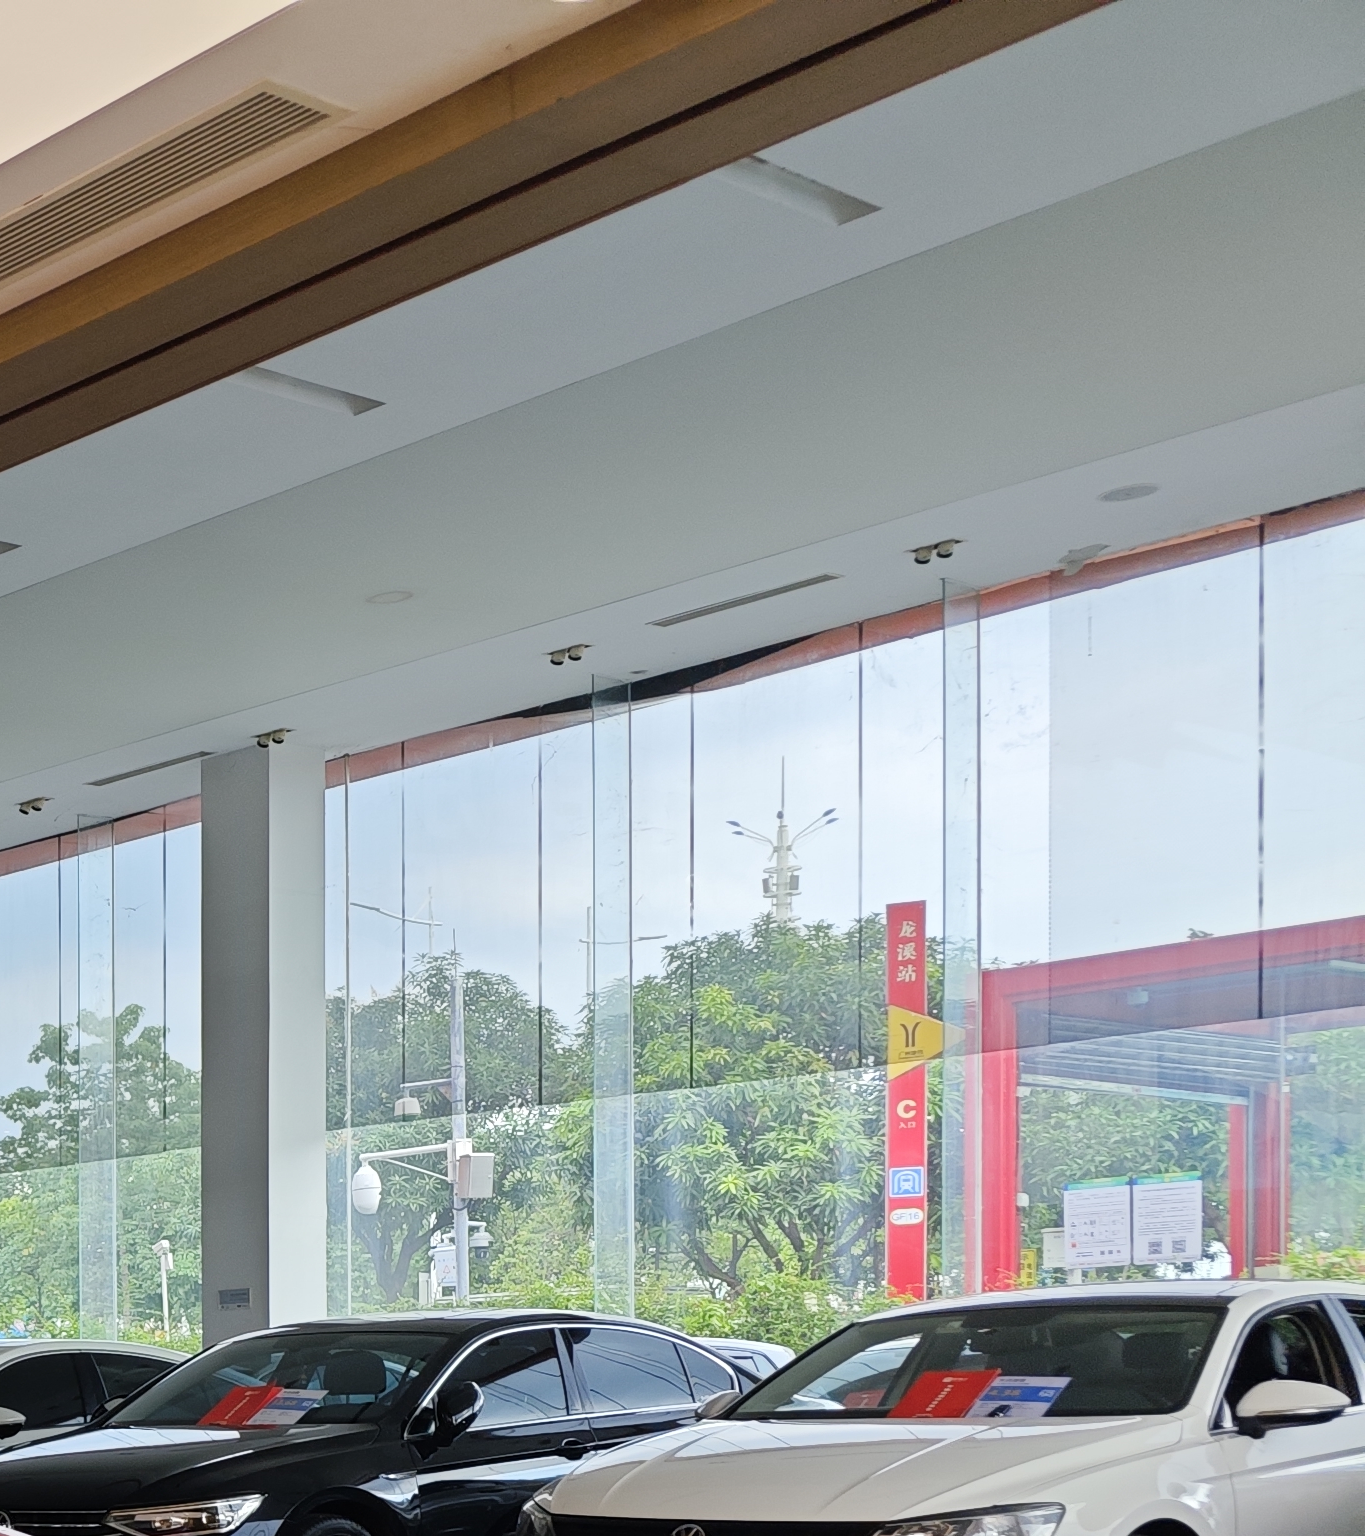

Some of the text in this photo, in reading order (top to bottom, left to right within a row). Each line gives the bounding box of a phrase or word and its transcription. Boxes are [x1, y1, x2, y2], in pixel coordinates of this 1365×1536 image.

[896, 920, 917, 982] 龙溪站
[897, 1099, 917, 1118] C
[898, 1121, 917, 1129] 入口
